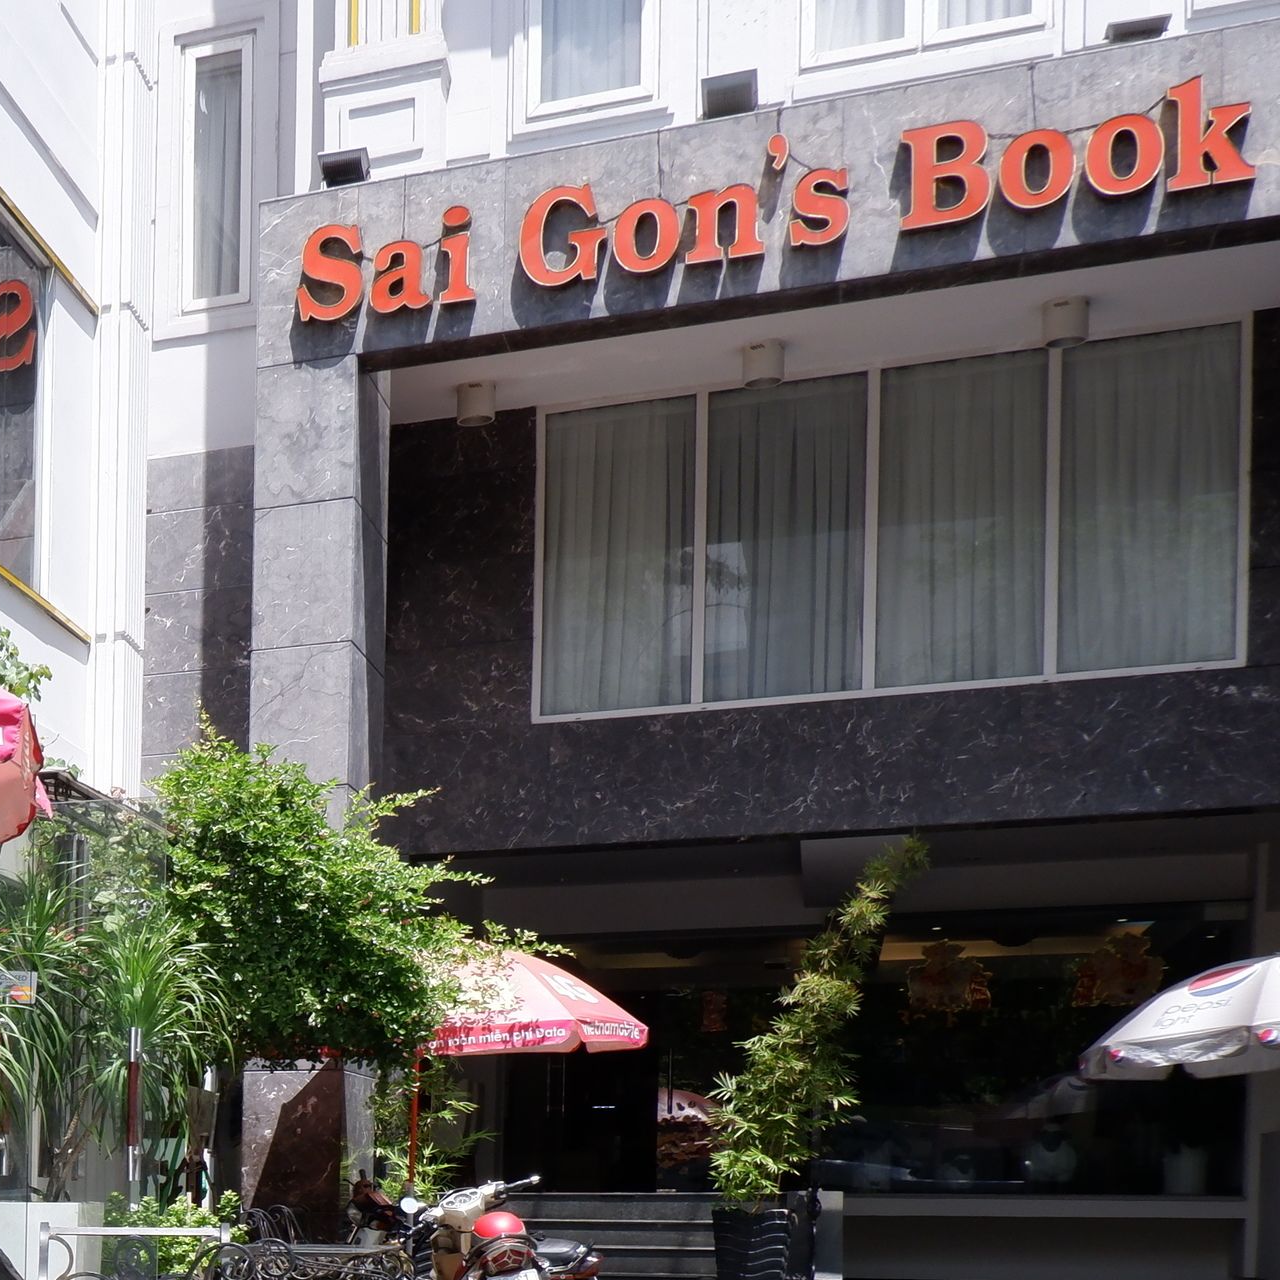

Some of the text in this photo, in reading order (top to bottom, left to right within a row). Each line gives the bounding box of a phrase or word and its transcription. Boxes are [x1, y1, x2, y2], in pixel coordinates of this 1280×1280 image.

[297, 74, 1257, 322] Sai Gon's Book
[1162, 996, 1233, 1016] pepsi
